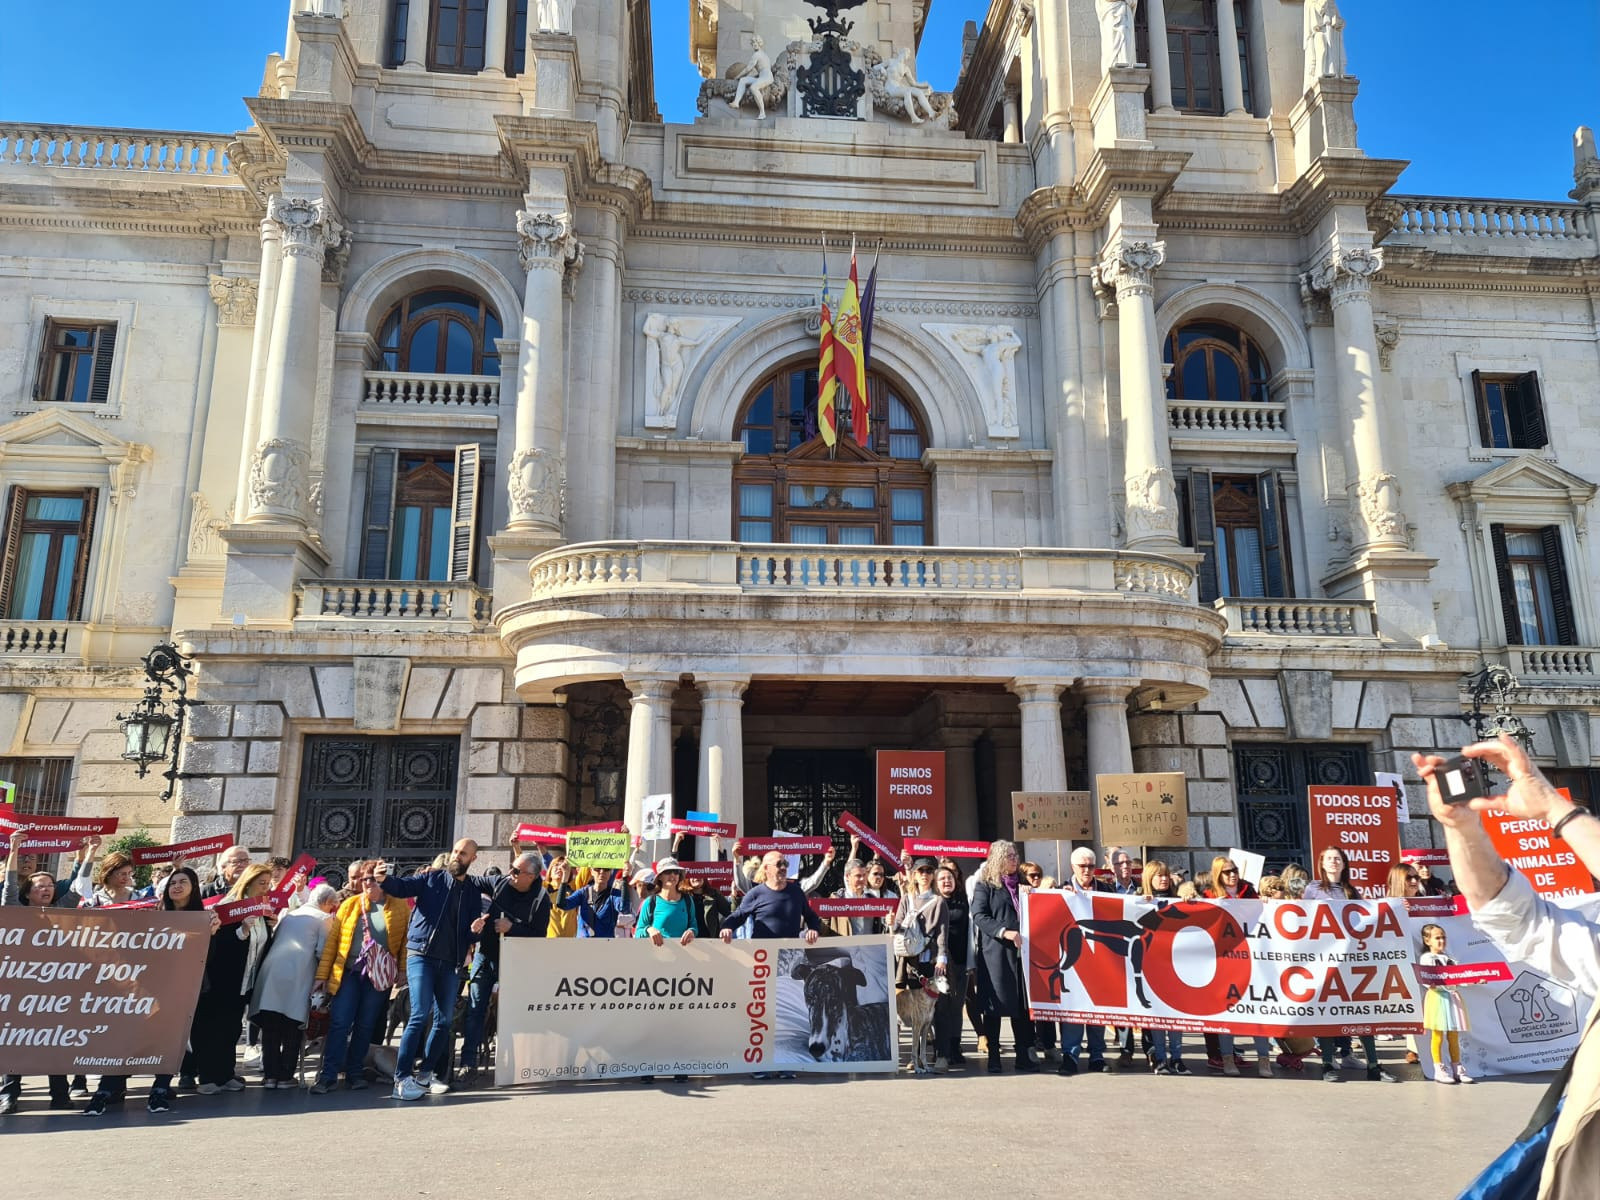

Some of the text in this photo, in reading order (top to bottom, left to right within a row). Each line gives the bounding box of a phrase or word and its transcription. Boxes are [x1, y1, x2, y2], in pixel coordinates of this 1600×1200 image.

[890, 768, 932, 778] MISMOS
[890, 784, 932, 795] PERROS
[1132, 799, 1146, 810] AL
[1314, 794, 1392, 808] TODOS LOS
[894, 809, 928, 820] MISMA
[1111, 812, 1178, 824] MALTRATO
[1326, 813, 1382, 826] PERROS
[901, 826, 921, 836] LEY
[1500, 819, 1553, 834] PERRO
[1340, 831, 1368, 844] SON
[1518, 836, 1550, 850] SON
[913, 844, 988, 854] #MismosPerrosMismaLey
[1343, 850, 1390, 862] MALES
[1349, 868, 1368, 880] DE
[1534, 873, 1556, 886] DE
[1222, 902, 1404, 950] A LA CAÇA
[32, 924, 186, 950] civilización
[1222, 950, 1249, 959] AMB
[1253, 952, 1316, 962] LLEBRERS
[1328, 952, 1370, 962] ALTRES
[1372, 950, 1407, 960] RACES
[95, 964, 147, 984] por
[555, 973, 714, 997] ASOCIACIÓN
[1226, 964, 1412, 1003] A LA CAZA
[18, 994, 72, 1016] que
[80, 992, 154, 1014] trata
[528, 1003, 585, 1012] RESCATE
[600, 1002, 665, 1010] ADOPCIÓN
[744, 949, 770, 1064] SoyGalgo
[1226, 1004, 1415, 1016] CON GALGOS Y OTRAS RAZAS
[73, 1055, 162, 1066] Mahatma Gandhi
[533, 1065, 587, 1078] soy_galgo
[673, 1061, 729, 1071] Asociación
